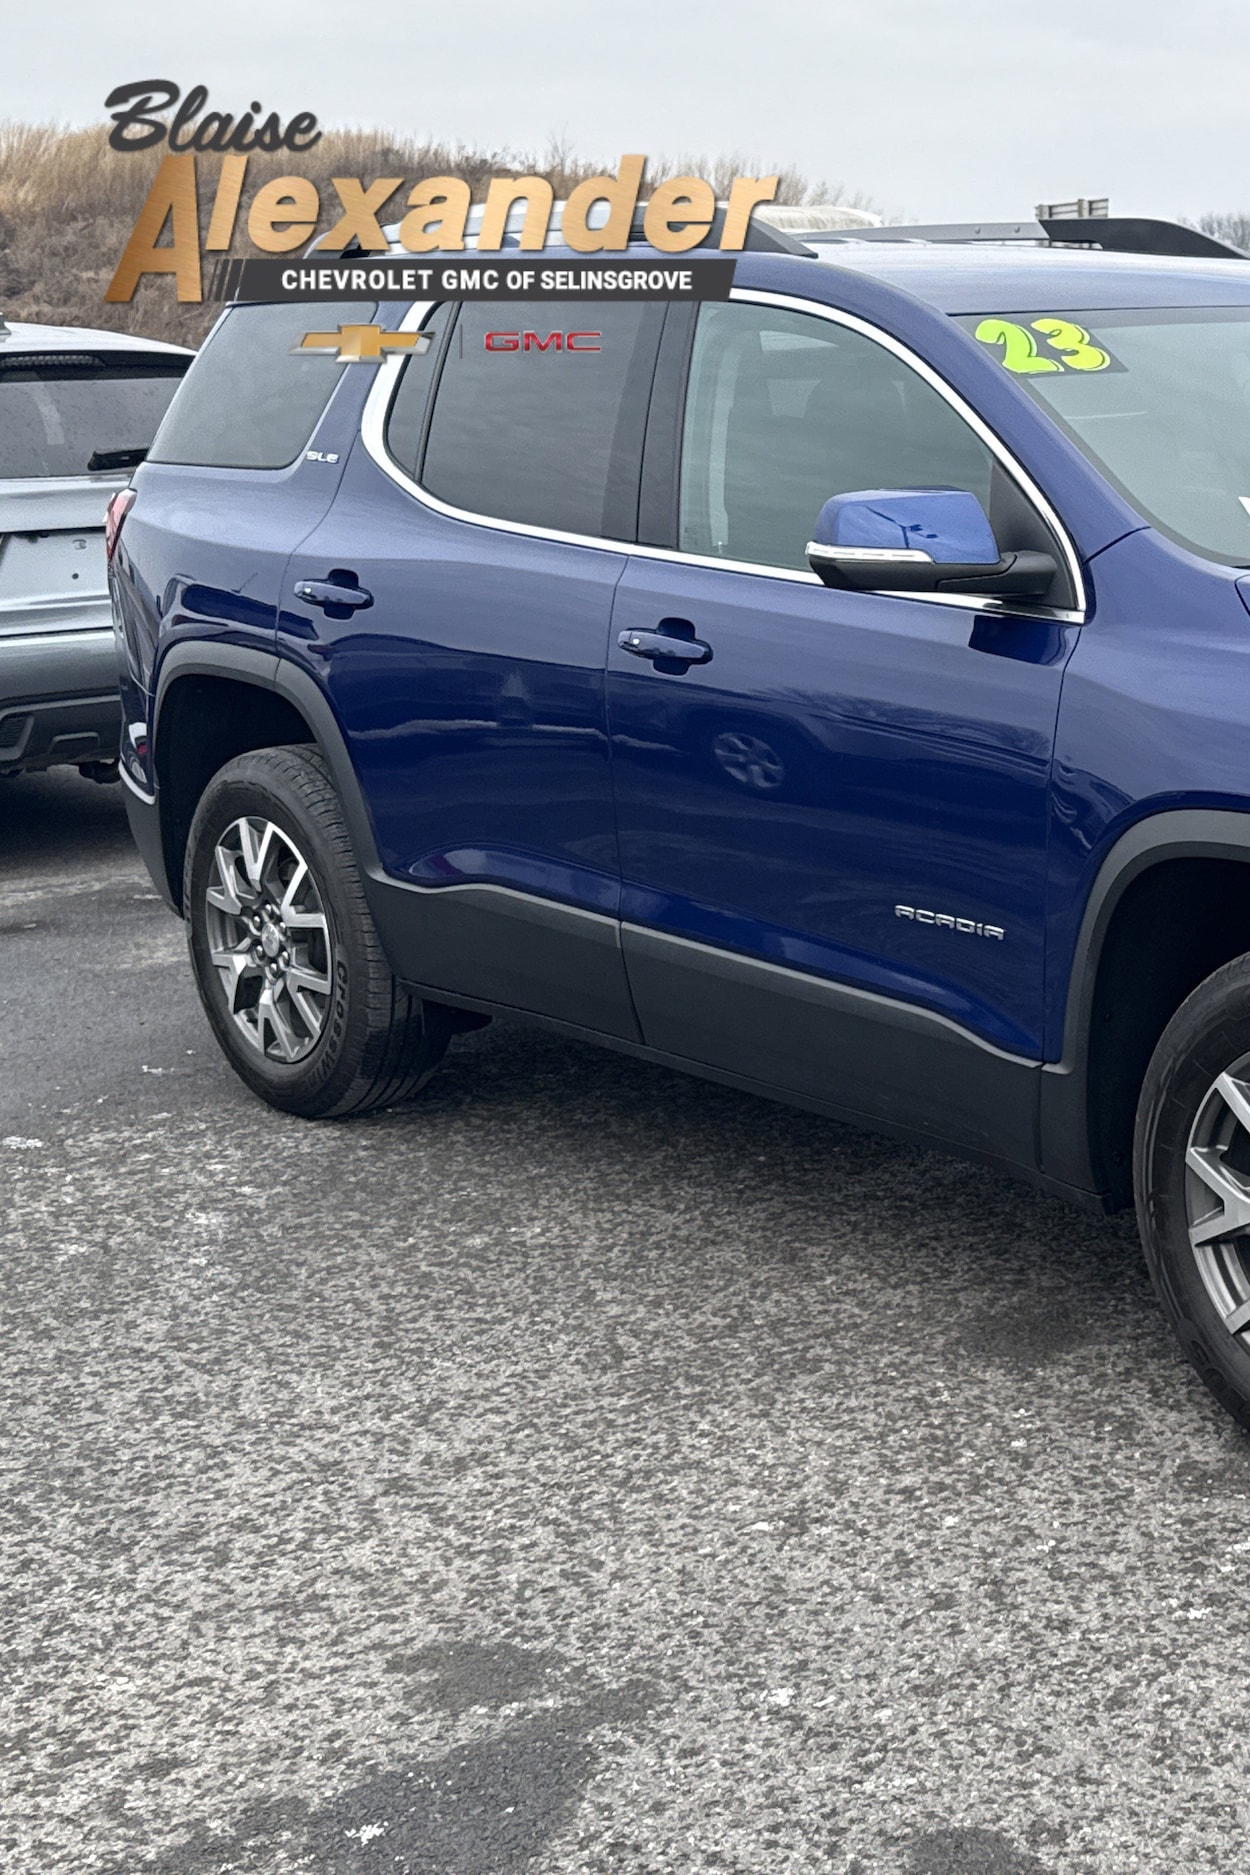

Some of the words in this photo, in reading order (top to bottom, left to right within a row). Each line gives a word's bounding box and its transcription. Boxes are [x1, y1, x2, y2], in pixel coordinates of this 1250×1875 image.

[975, 318, 1111, 373] 23
[306, 450, 339, 464] SLE
[894, 904, 1005, 940] ACADIA
